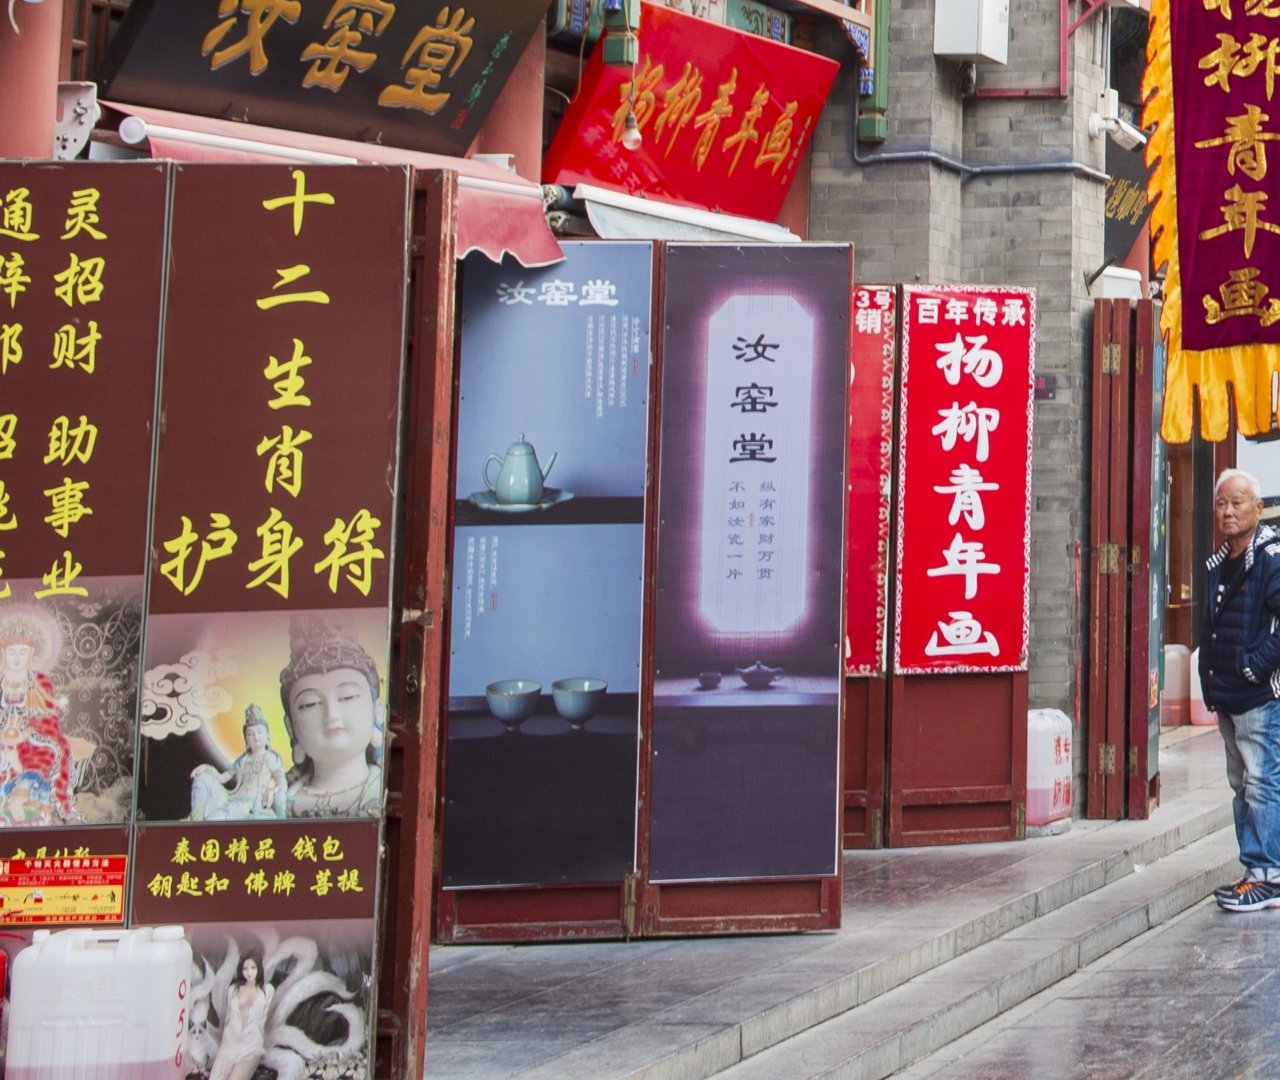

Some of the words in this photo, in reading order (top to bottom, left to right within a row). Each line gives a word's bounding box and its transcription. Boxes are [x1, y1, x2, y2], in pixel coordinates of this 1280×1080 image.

[49, 186, 107, 375] 灵招财
[496, 279, 619, 307] 汝窑堂
[916, 298, 1026, 327] 百年传承
[256, 170, 335, 499] 十二生肖
[729, 334, 781, 464] 汝窑堂
[34, 415, 99, 600] 助事业
[160, 507, 386, 599] 护身符
[147, 871, 230, 899] 钥匙扣
[244, 871, 297, 896] 佛牌
[310, 869, 364, 896] 菩提
[170, 836, 277, 864] 泰国精品
[292, 835, 344, 863] 钱包
